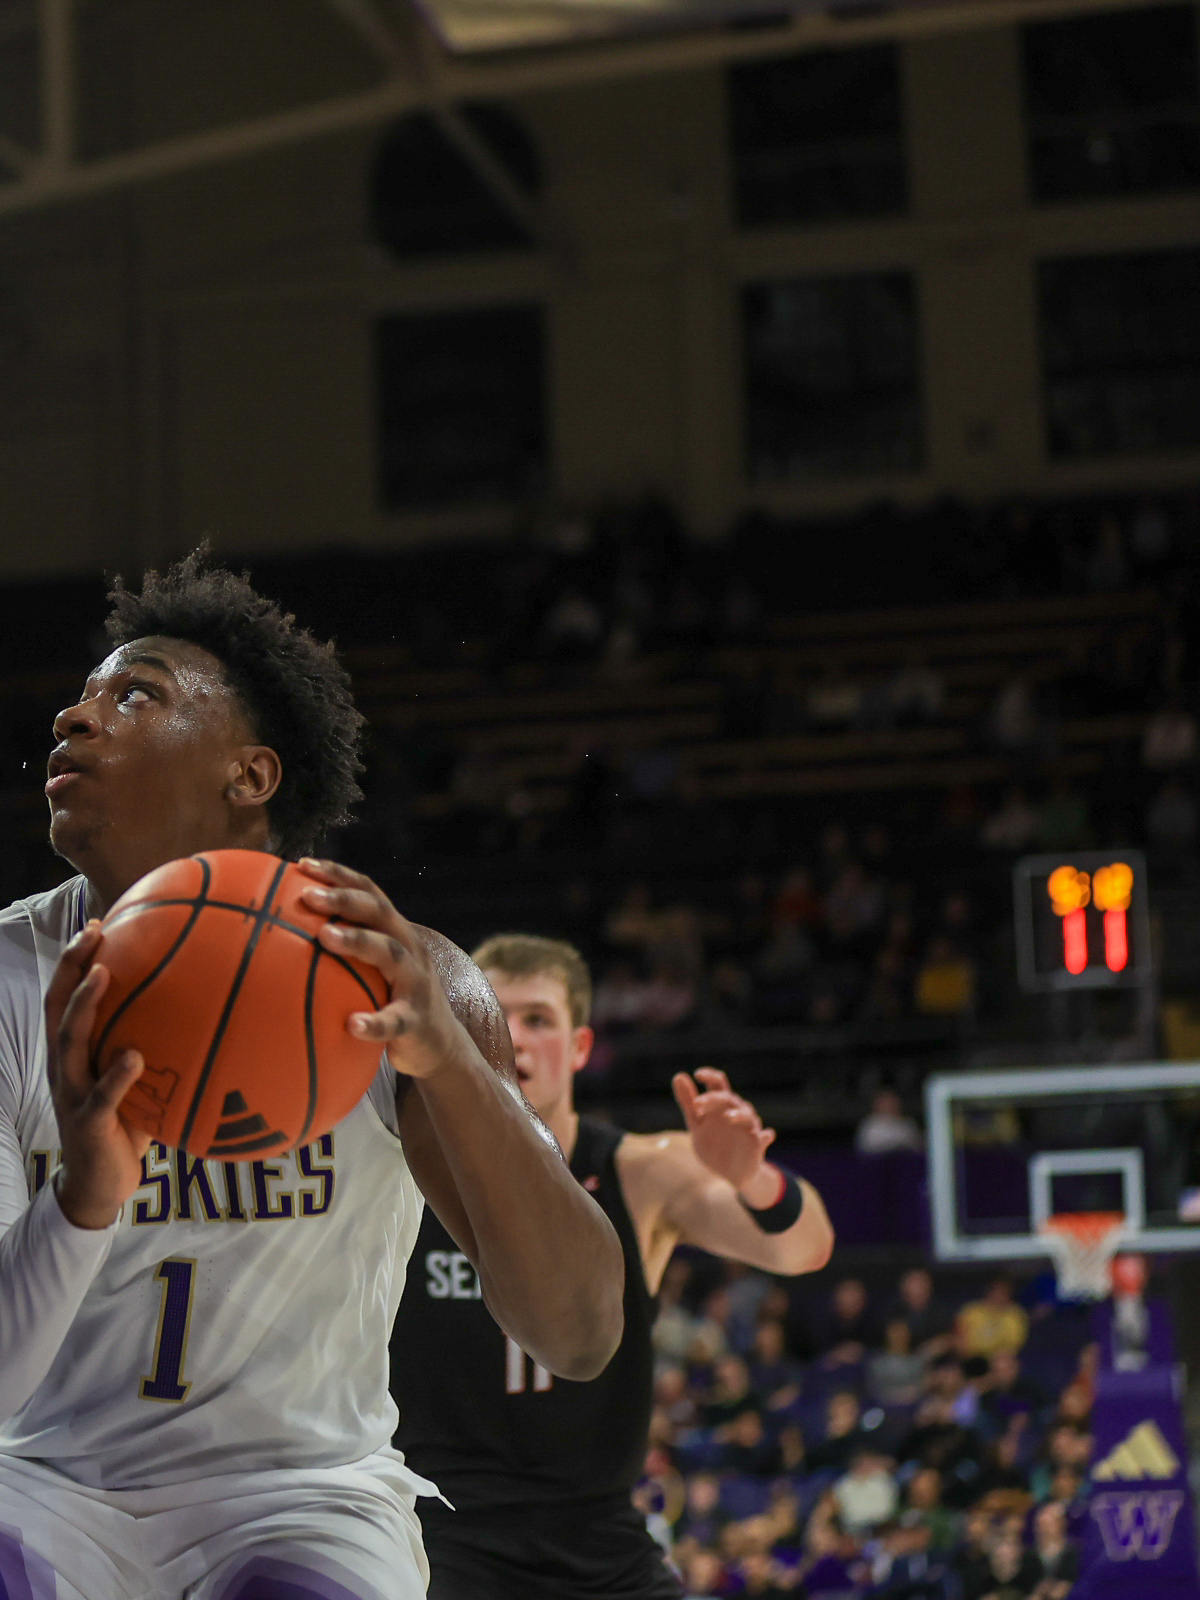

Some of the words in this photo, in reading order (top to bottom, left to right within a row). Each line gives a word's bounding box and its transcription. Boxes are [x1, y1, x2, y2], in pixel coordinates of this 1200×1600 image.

[31, 1131, 335, 1226] SKIES
[138, 1256, 197, 1403] 1
[1090, 1490, 1184, 1561] W
